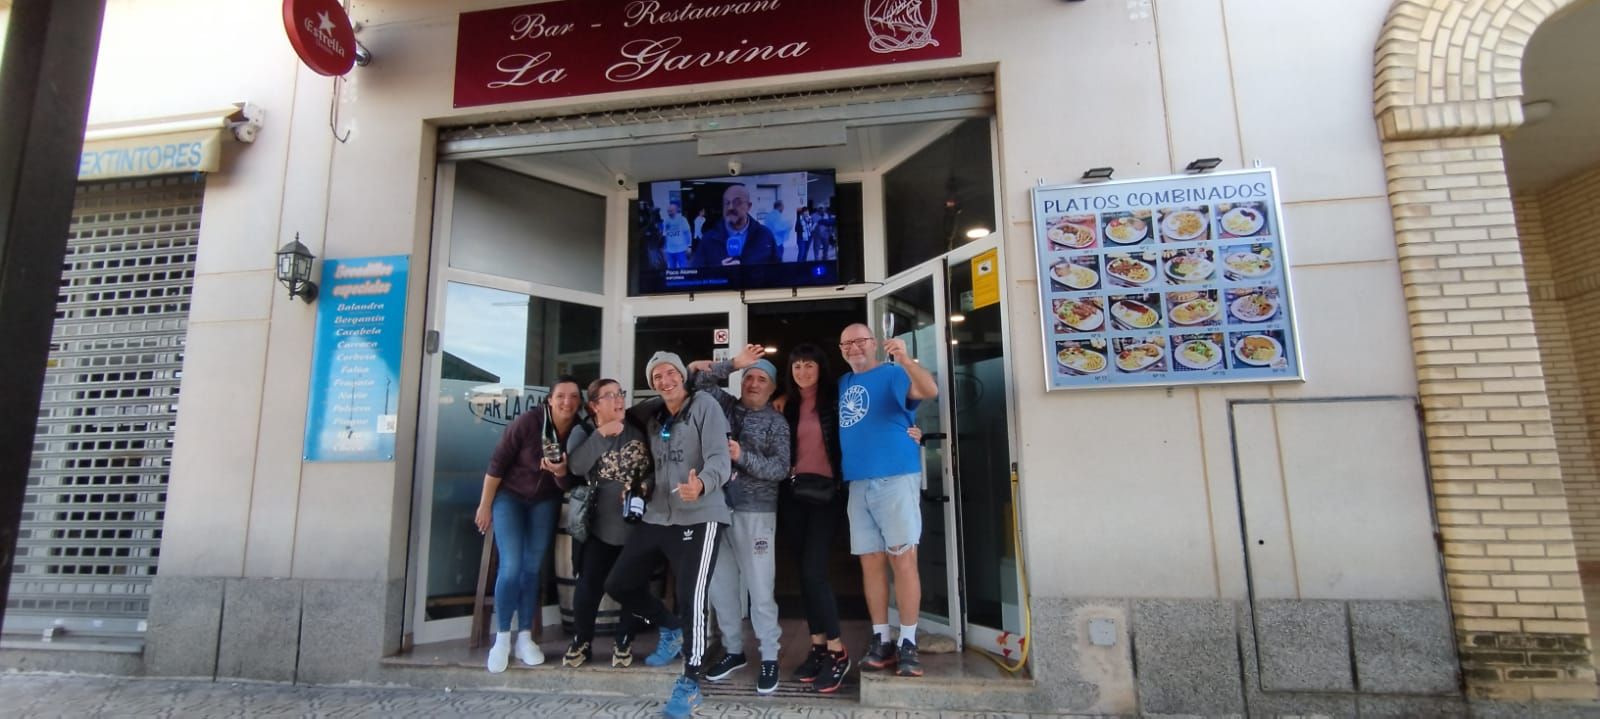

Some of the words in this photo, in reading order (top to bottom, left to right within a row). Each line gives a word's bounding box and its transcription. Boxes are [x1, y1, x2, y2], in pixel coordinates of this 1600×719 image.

[510, 13, 574, 40] Bar
[624, 0, 781, 27] Restaurant
[304, 17, 345, 58] Estrella
[487, 51, 567, 88] La
[605, 36, 810, 82] Gavina
[80, 142, 203, 175] EXTINTORES
[1044, 194, 1120, 213] PLATOS
[1127, 182, 1267, 206] COMBINADOS
[337, 302, 385, 312] Balandra
[505, 395, 521, 420] LA
